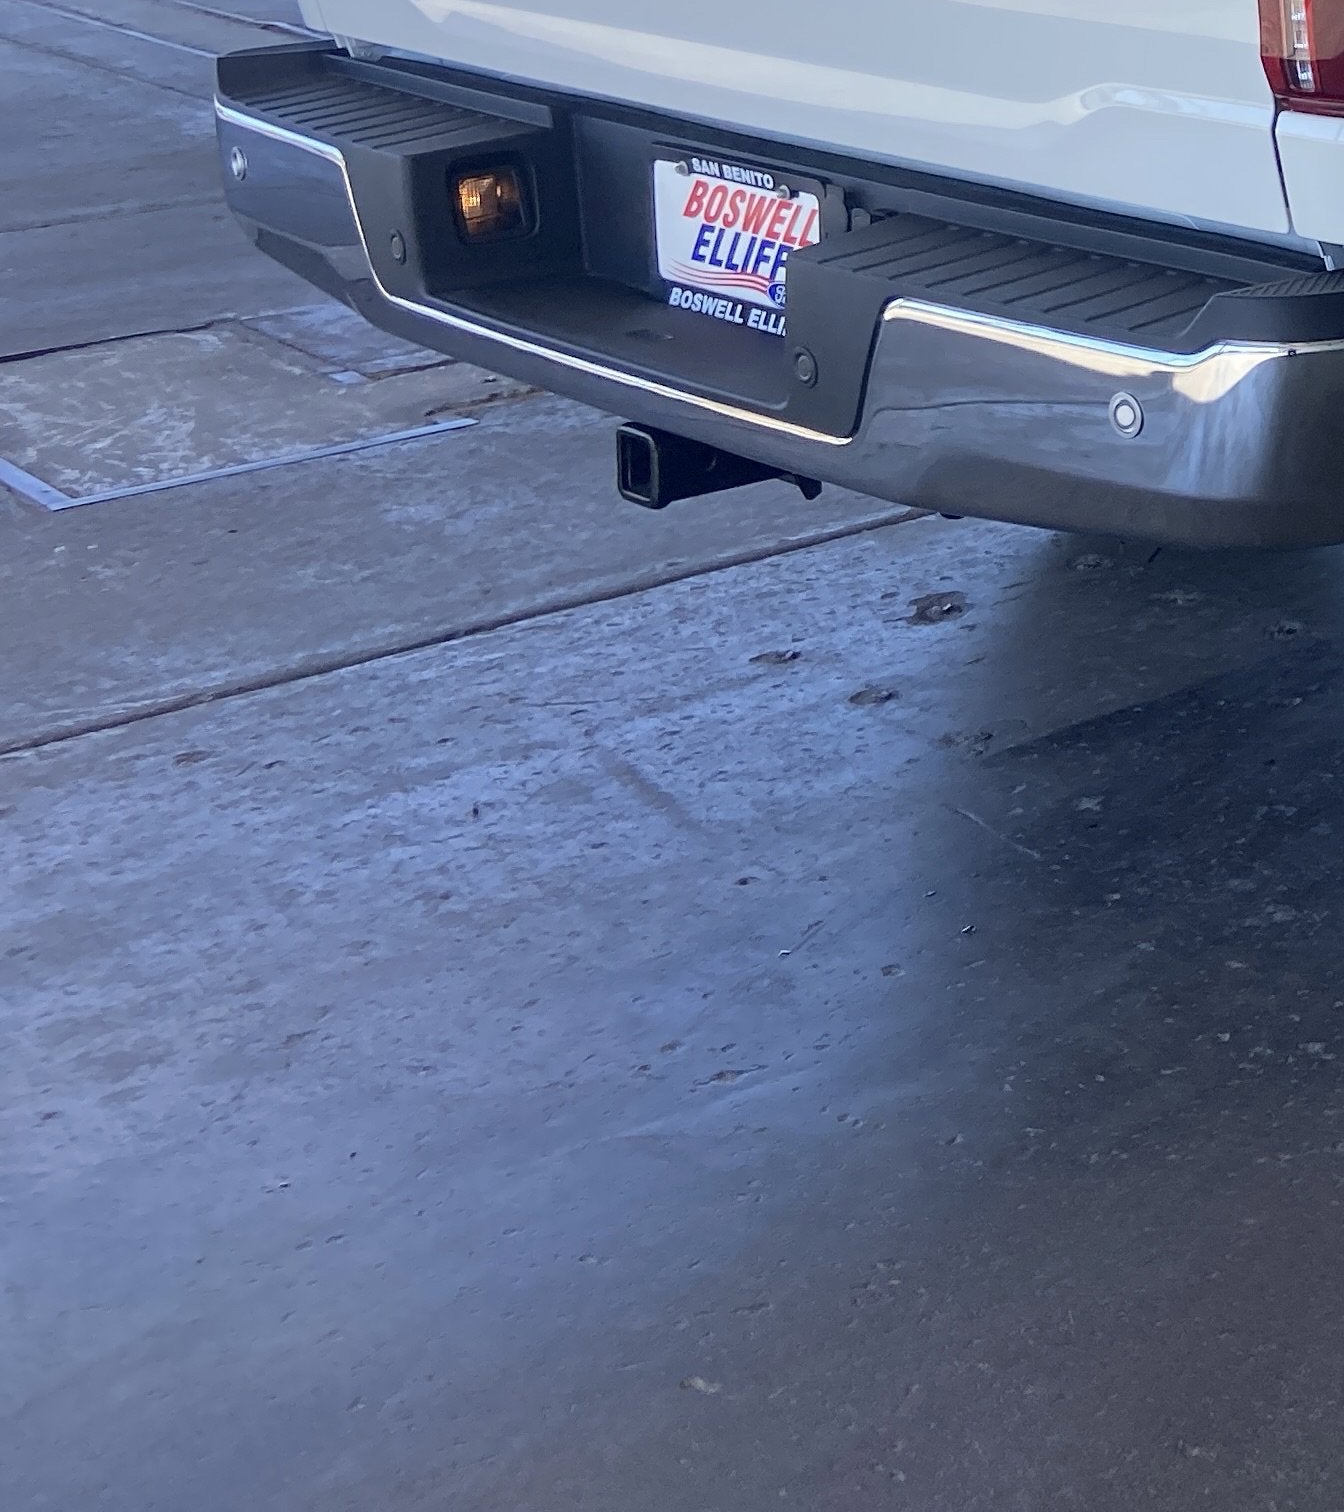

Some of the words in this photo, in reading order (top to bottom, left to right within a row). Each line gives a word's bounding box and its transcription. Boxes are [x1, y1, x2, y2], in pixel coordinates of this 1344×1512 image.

[692, 157, 721, 178] SAN
[723, 163, 774, 189] BENITO
[683, 179, 819, 248] BOSWELL
[691, 223, 794, 281] ELLIFF
[669, 287, 744, 324] BOSWELL
[747, 308, 786, 337] ELLI
